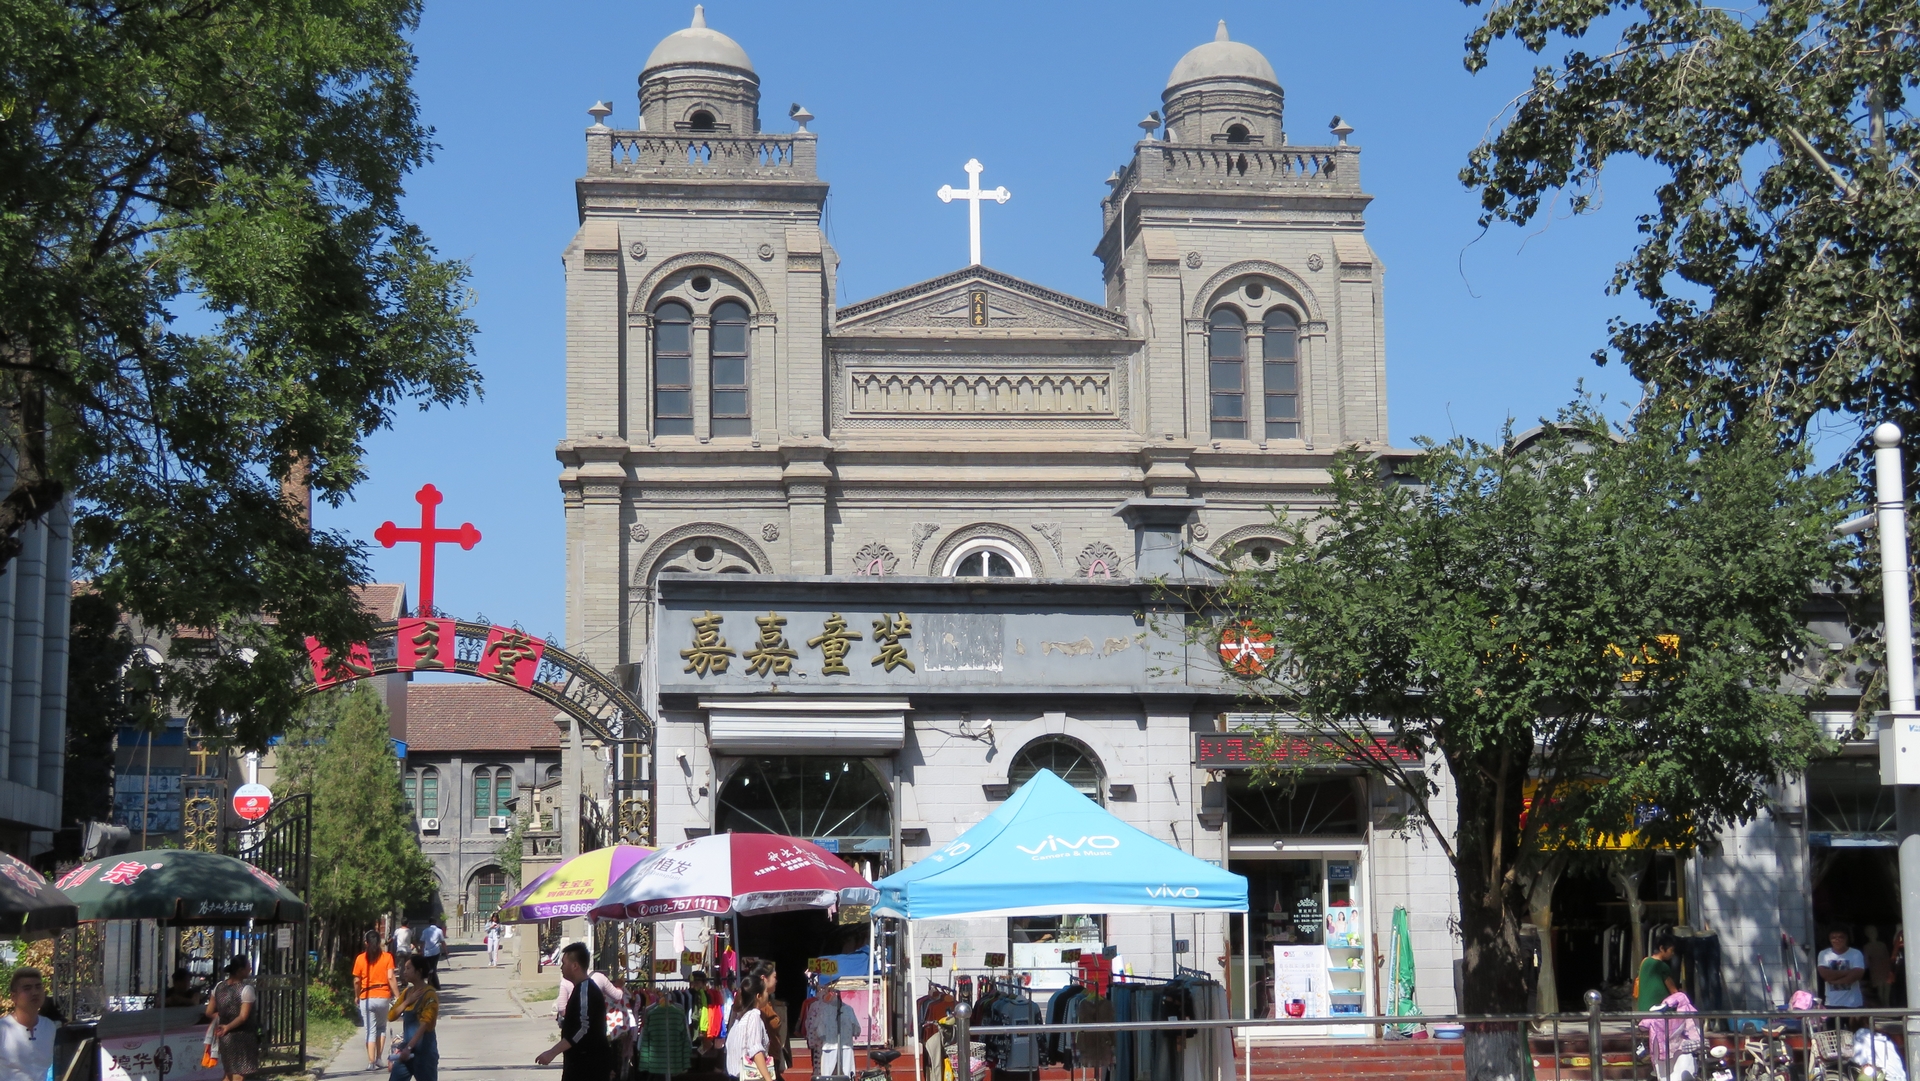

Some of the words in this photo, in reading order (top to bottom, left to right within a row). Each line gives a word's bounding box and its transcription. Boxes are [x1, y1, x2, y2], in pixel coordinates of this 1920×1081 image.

[974, 293, 984, 325] 天主堂
[680, 609, 915, 679] 嘉嘉童装
[1016, 835, 1120, 855] vivo
[1031, 851, 1070, 861] Camera
[1084, 849, 1112, 857] Music
[557, 879, 595, 889] 生宝宝
[1146, 884, 1199, 898] vivo
[552, 904, 568, 914] 679
[649, 898, 692, 914] 0312-757
[694, 898, 719, 911] 1111
[1176, 942, 1185, 952] 10
[688, 952, 702, 964] 49
[928, 954, 941, 967] 35
[991, 953, 1005, 966] 69
[662, 960, 676, 972] 20
[826, 961, 836, 973] 20
